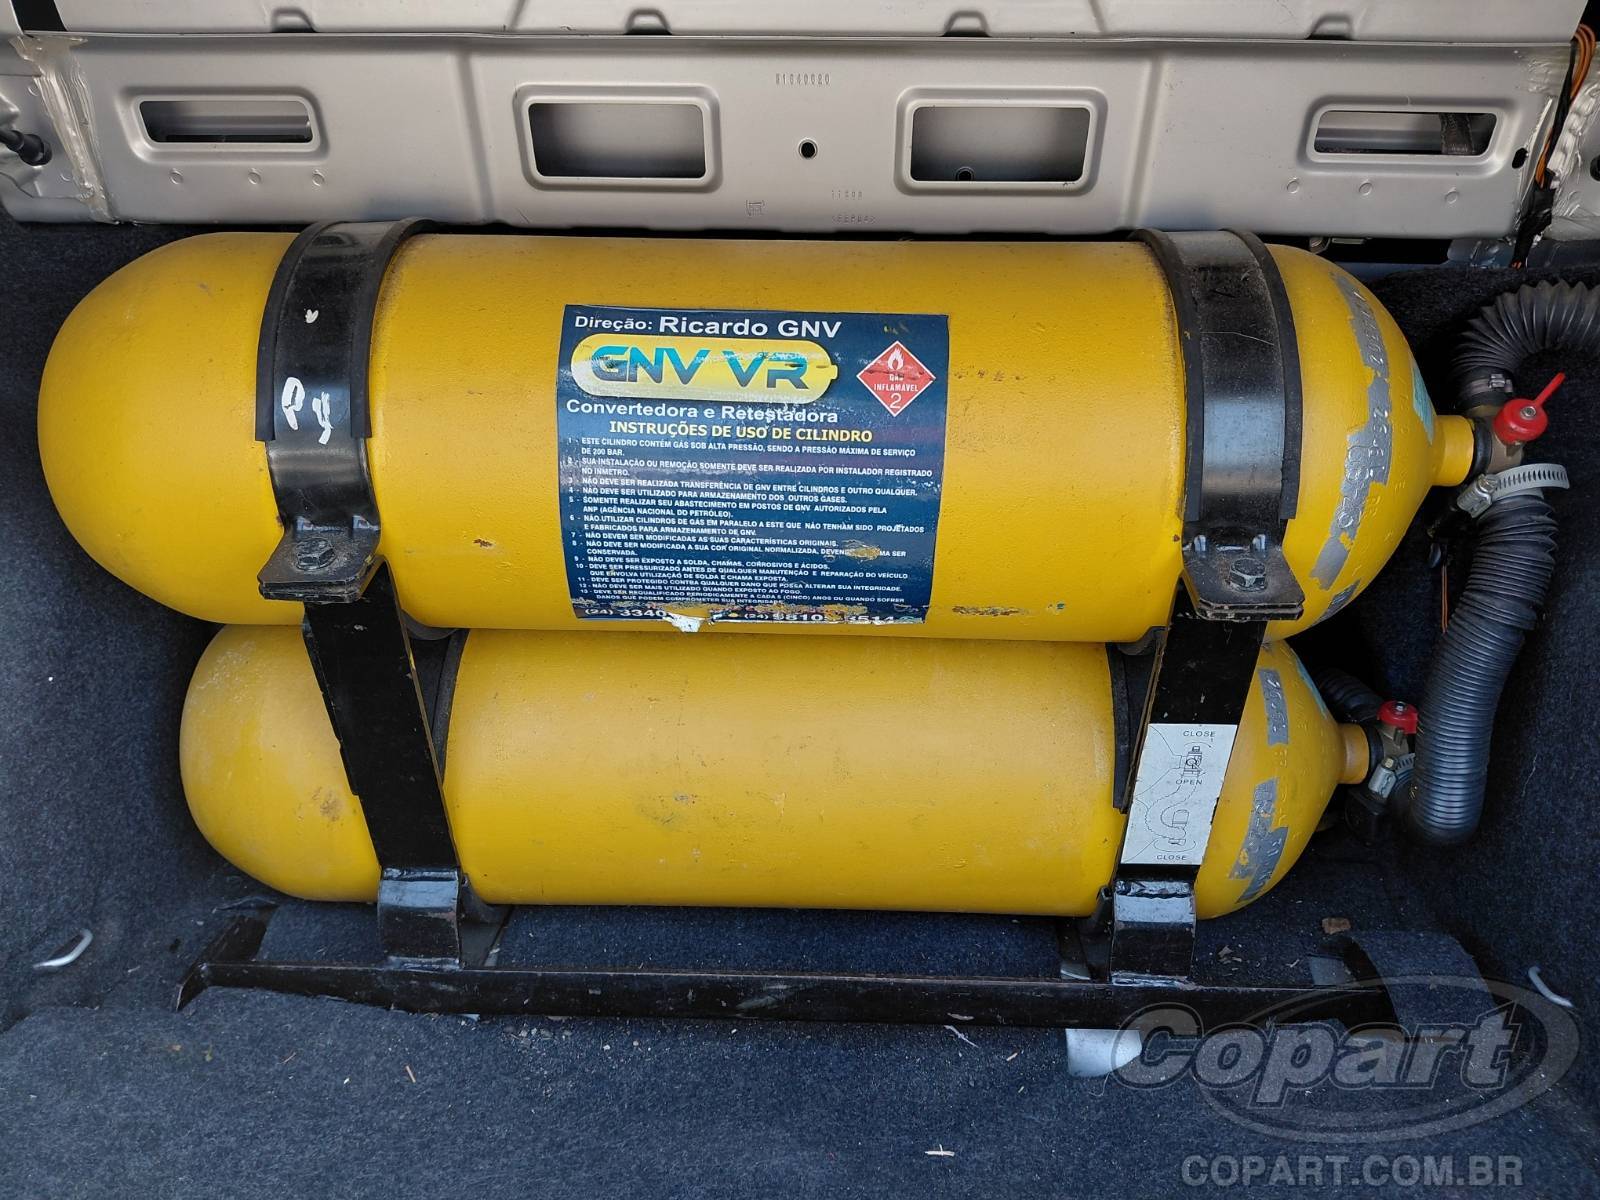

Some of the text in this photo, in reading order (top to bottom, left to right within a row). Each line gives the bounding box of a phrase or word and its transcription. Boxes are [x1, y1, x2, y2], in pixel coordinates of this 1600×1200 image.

[574, 315, 842, 338] Direção: Ricardo GNV
[591, 345, 809, 390] GNV VR
[566, 399, 838, 423] Convertedora e Retestadora
[889, 392, 902, 409] 2
[609, 420, 873, 443] INSTRUÇÕES DE USO DE CILINDRO
[673, 440, 688, 448] GÁS
